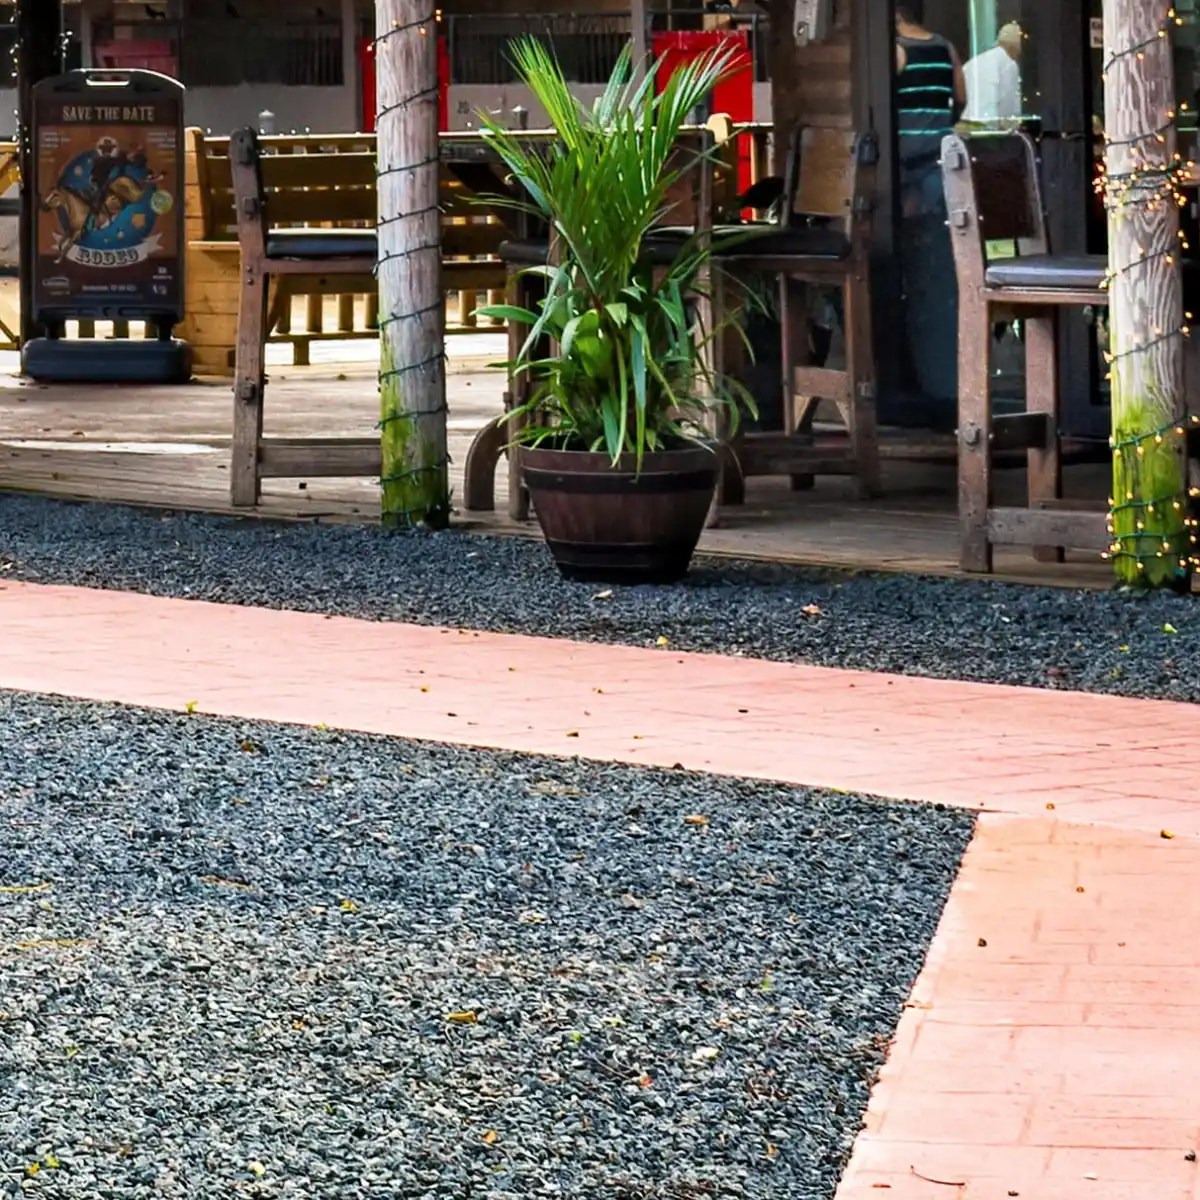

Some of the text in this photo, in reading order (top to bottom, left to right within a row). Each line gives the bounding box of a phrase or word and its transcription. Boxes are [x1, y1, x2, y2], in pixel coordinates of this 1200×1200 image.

[62, 105, 155, 123] SAVE THE DATE
[75, 247, 139, 266] RODEO
